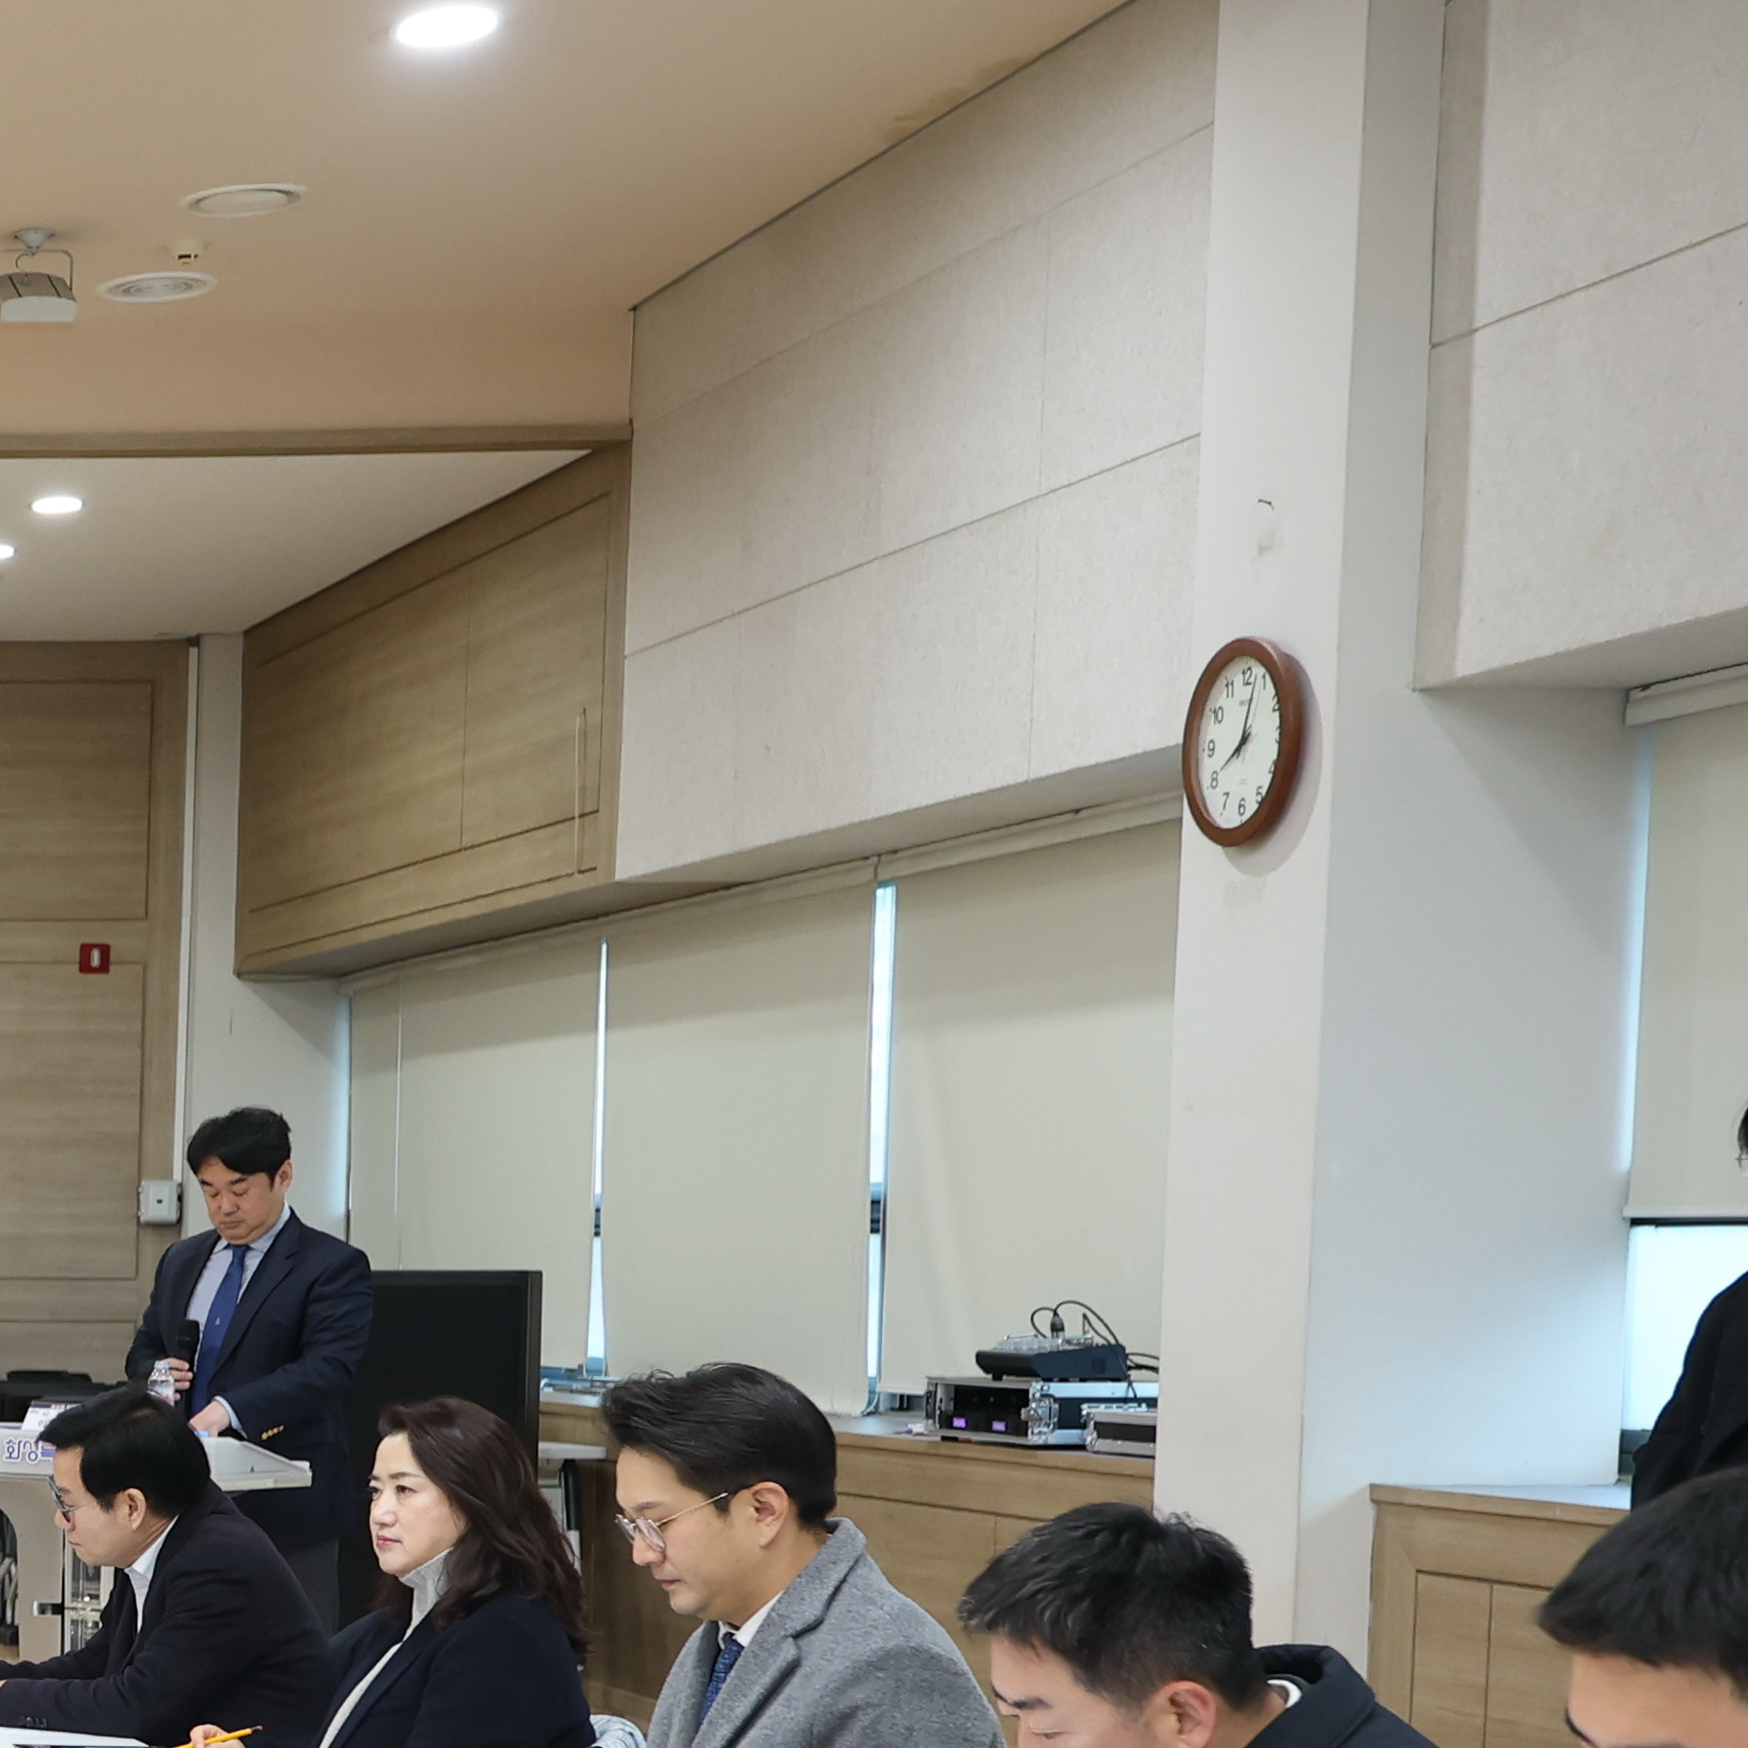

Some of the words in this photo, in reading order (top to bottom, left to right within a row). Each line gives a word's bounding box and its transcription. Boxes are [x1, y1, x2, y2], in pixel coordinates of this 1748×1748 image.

[1242, 667, 1253, 686] 12
[1261, 674, 1267, 690] 1
[1225, 681, 1234, 698] 11
[1213, 706, 1224, 724] 10
[1207, 739, 1215, 757] 9
[1210, 770, 1219, 789] 8
[1222, 792, 1230, 811] 7
[1238, 798, 1246, 816] 6
